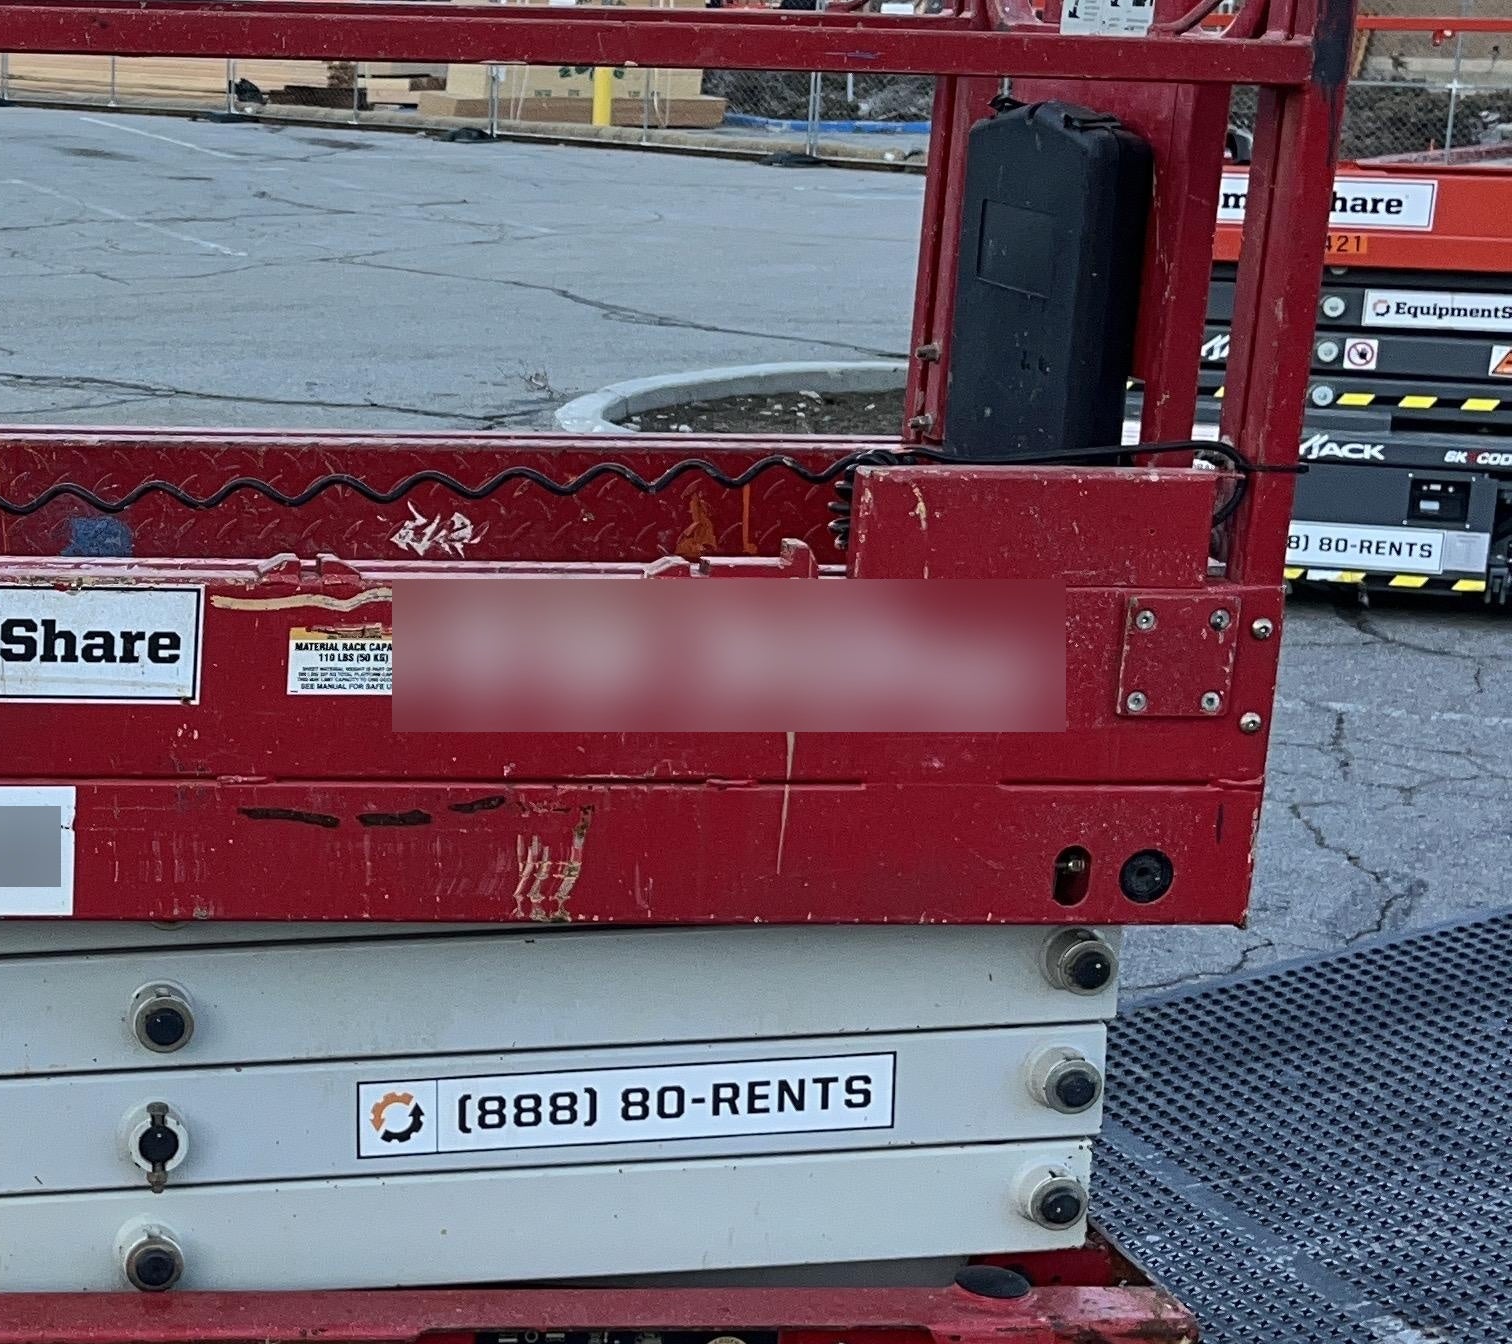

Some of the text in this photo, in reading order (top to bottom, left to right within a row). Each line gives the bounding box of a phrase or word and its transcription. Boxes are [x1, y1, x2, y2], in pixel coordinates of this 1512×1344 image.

[1318, 537, 1433, 559] 80-RENTS
[294, 642, 339, 651] MATERIAL
[342, 642, 366, 651] RACK
[318, 653, 389, 664] 110 LBS (50 KG)
[457, 1074, 873, 1134] (888) 80-RENTS
